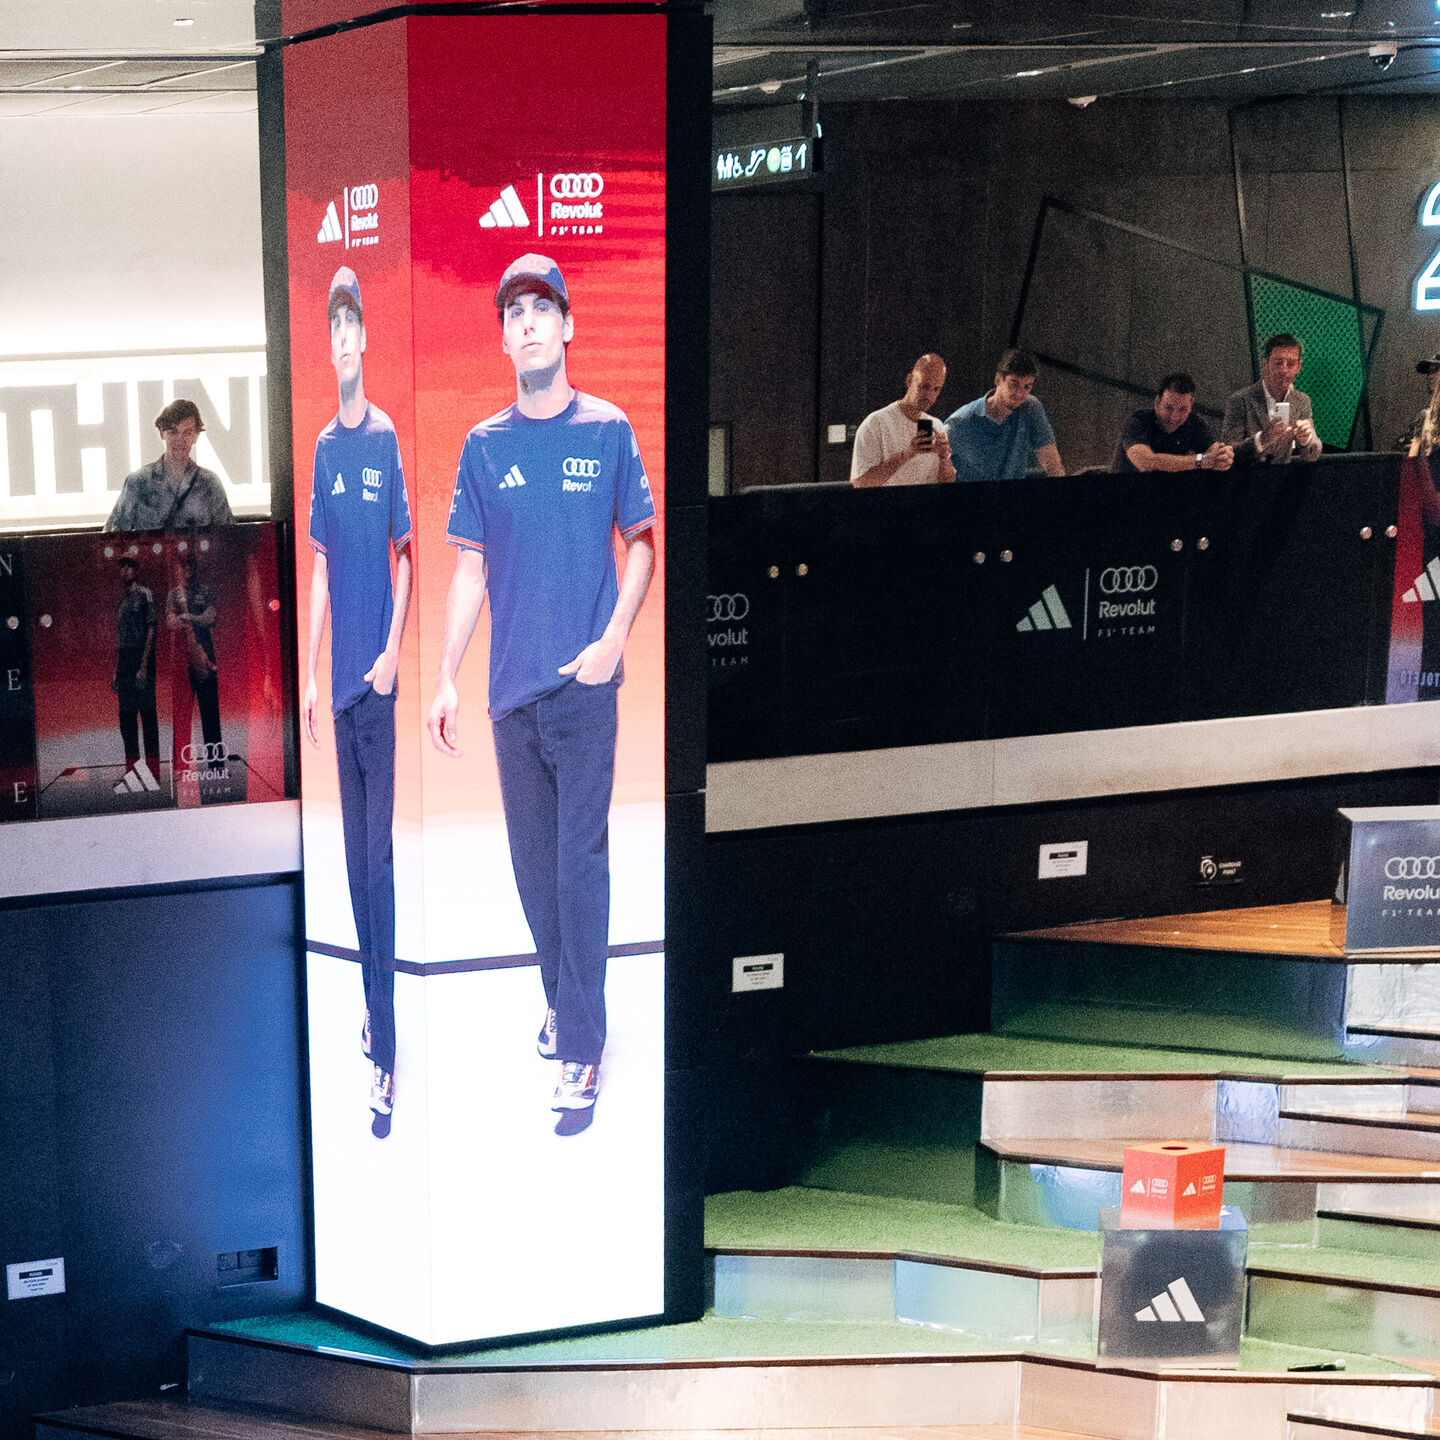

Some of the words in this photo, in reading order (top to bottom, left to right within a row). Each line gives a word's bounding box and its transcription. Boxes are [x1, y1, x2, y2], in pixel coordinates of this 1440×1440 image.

[550, 202, 604, 220] Revolut
[571, 225, 604, 236] TEAM
[1099, 599, 1156, 618] Revolut
[707, 629, 748, 648] volut
[1120, 625, 1156, 636] TEAM
[180, 767, 232, 784] Revolut
[1383, 884, 1440, 901] Revolu
